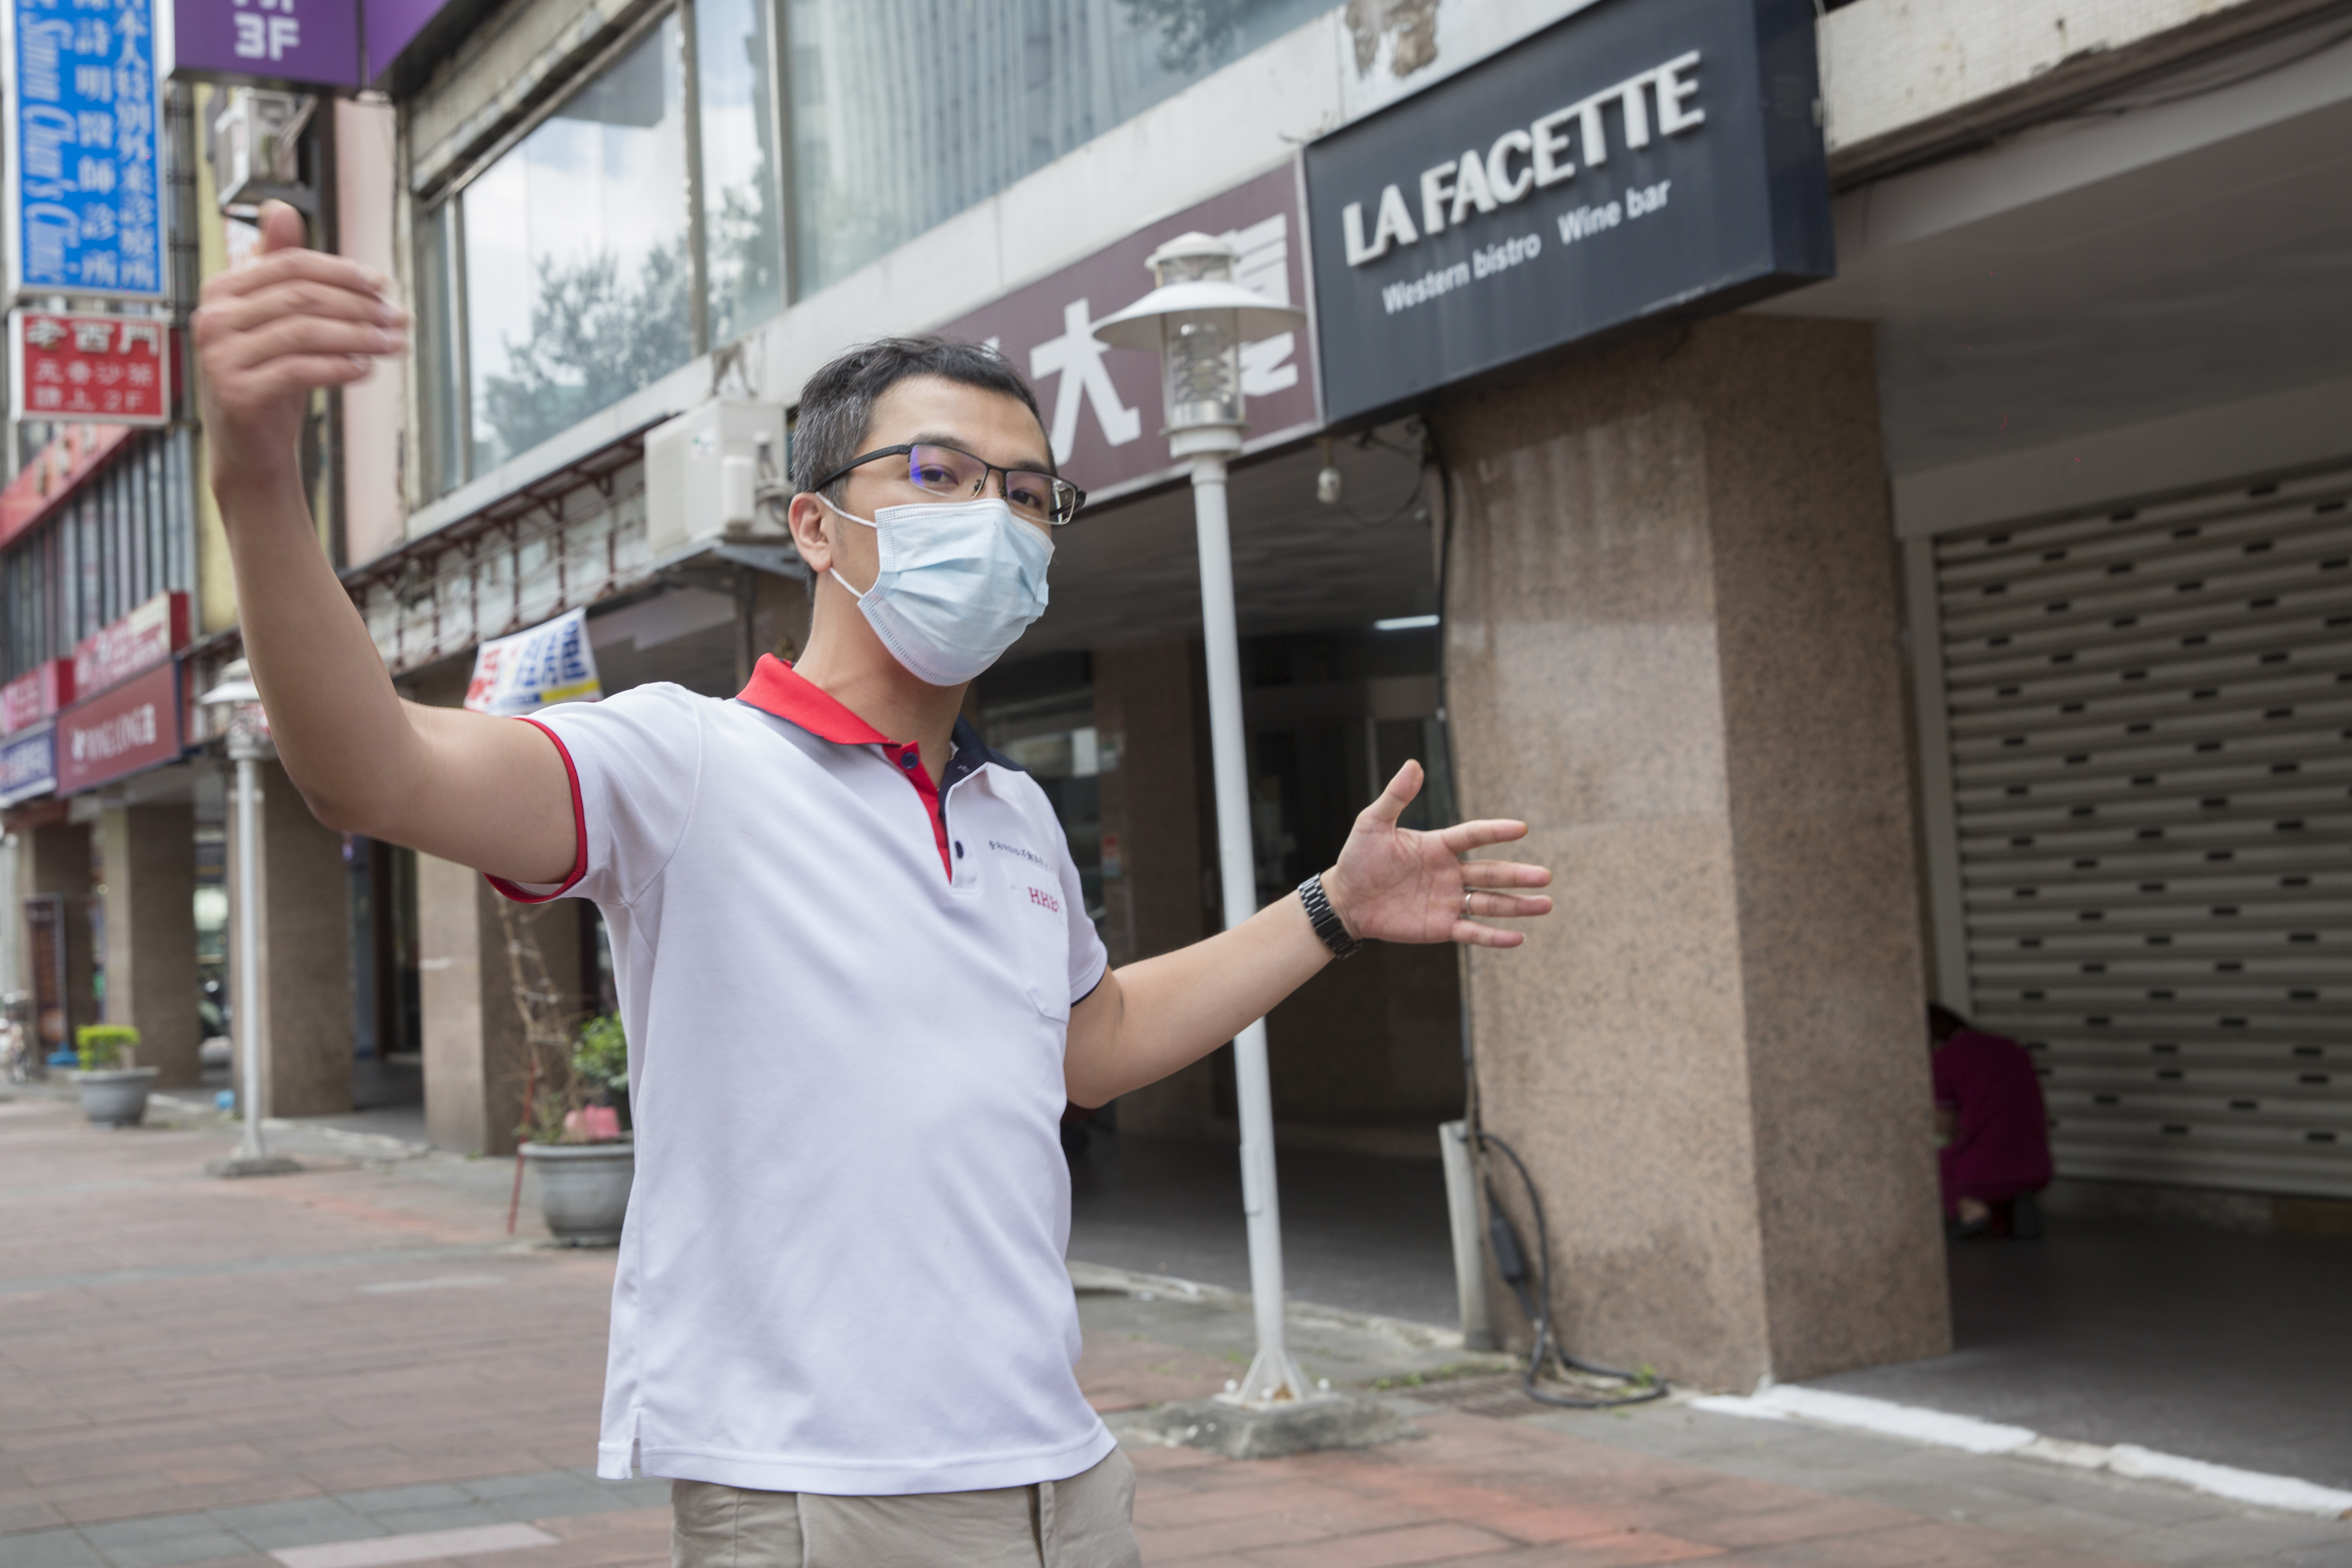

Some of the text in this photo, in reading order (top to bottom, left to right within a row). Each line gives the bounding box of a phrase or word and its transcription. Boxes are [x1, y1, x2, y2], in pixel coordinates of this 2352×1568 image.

[234, 12, 300, 61] 3F
[1342, 49, 1706, 267] LA FACETTE
[1382, 179, 1671, 315] Western bistro Wine bar
